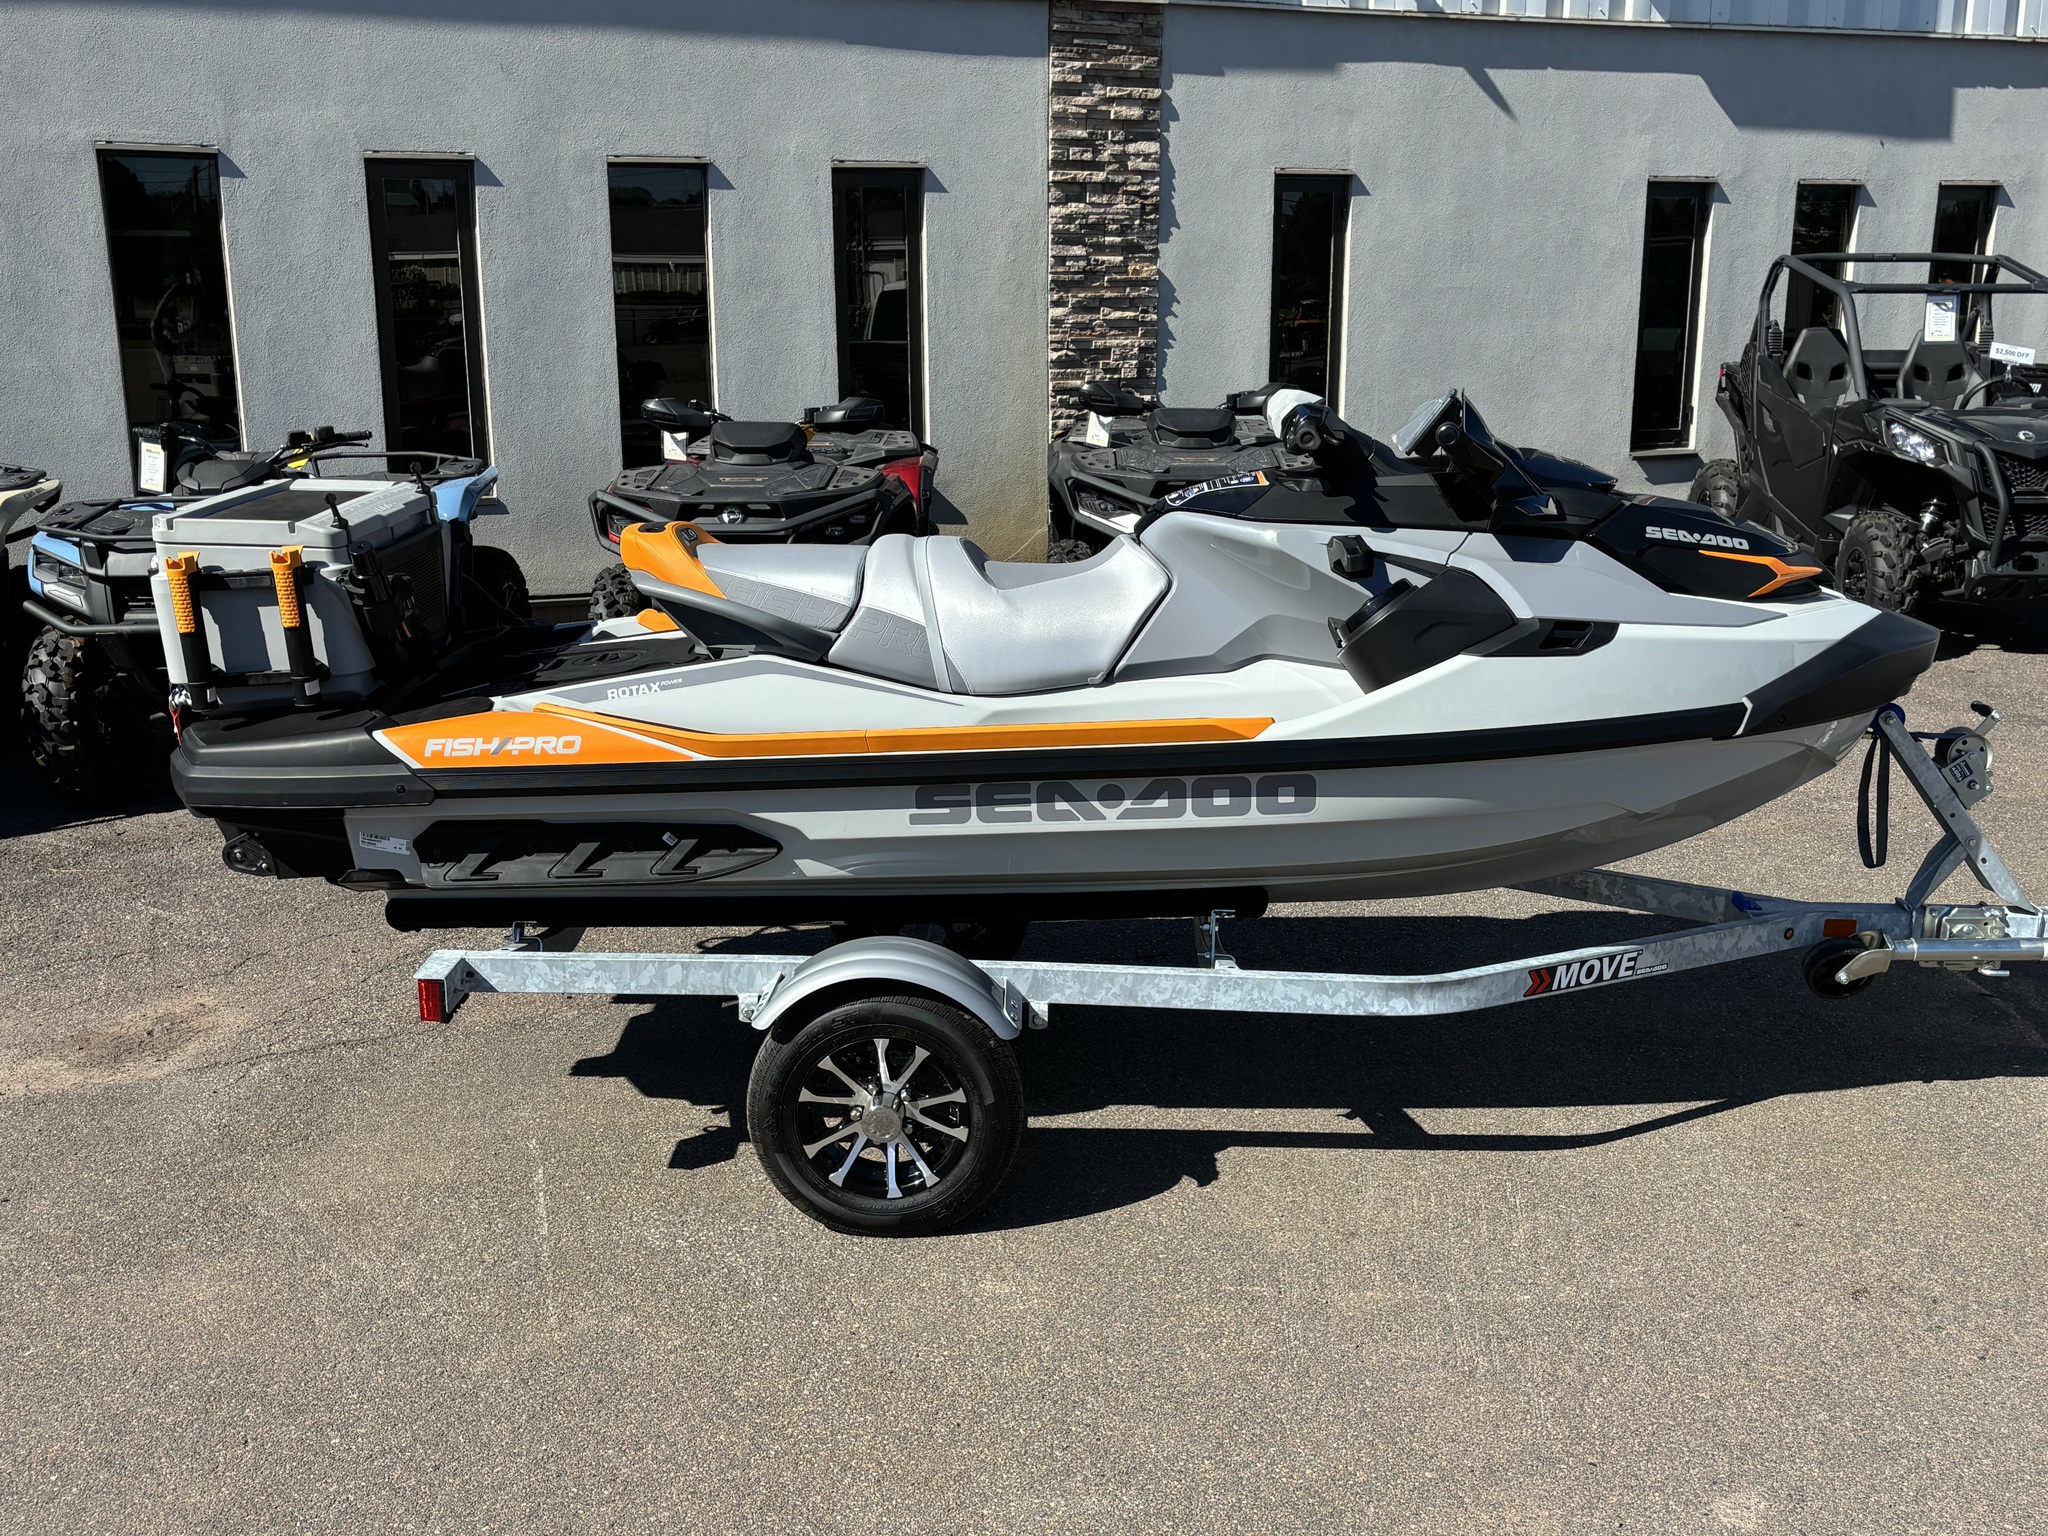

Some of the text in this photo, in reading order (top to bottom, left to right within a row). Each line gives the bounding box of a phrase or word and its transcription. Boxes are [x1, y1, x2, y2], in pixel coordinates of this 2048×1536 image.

[2016, 351, 2030, 359] OFF
[607, 678, 683, 700] ROTAX POWER
[1552, 952, 1638, 991] MOVE
